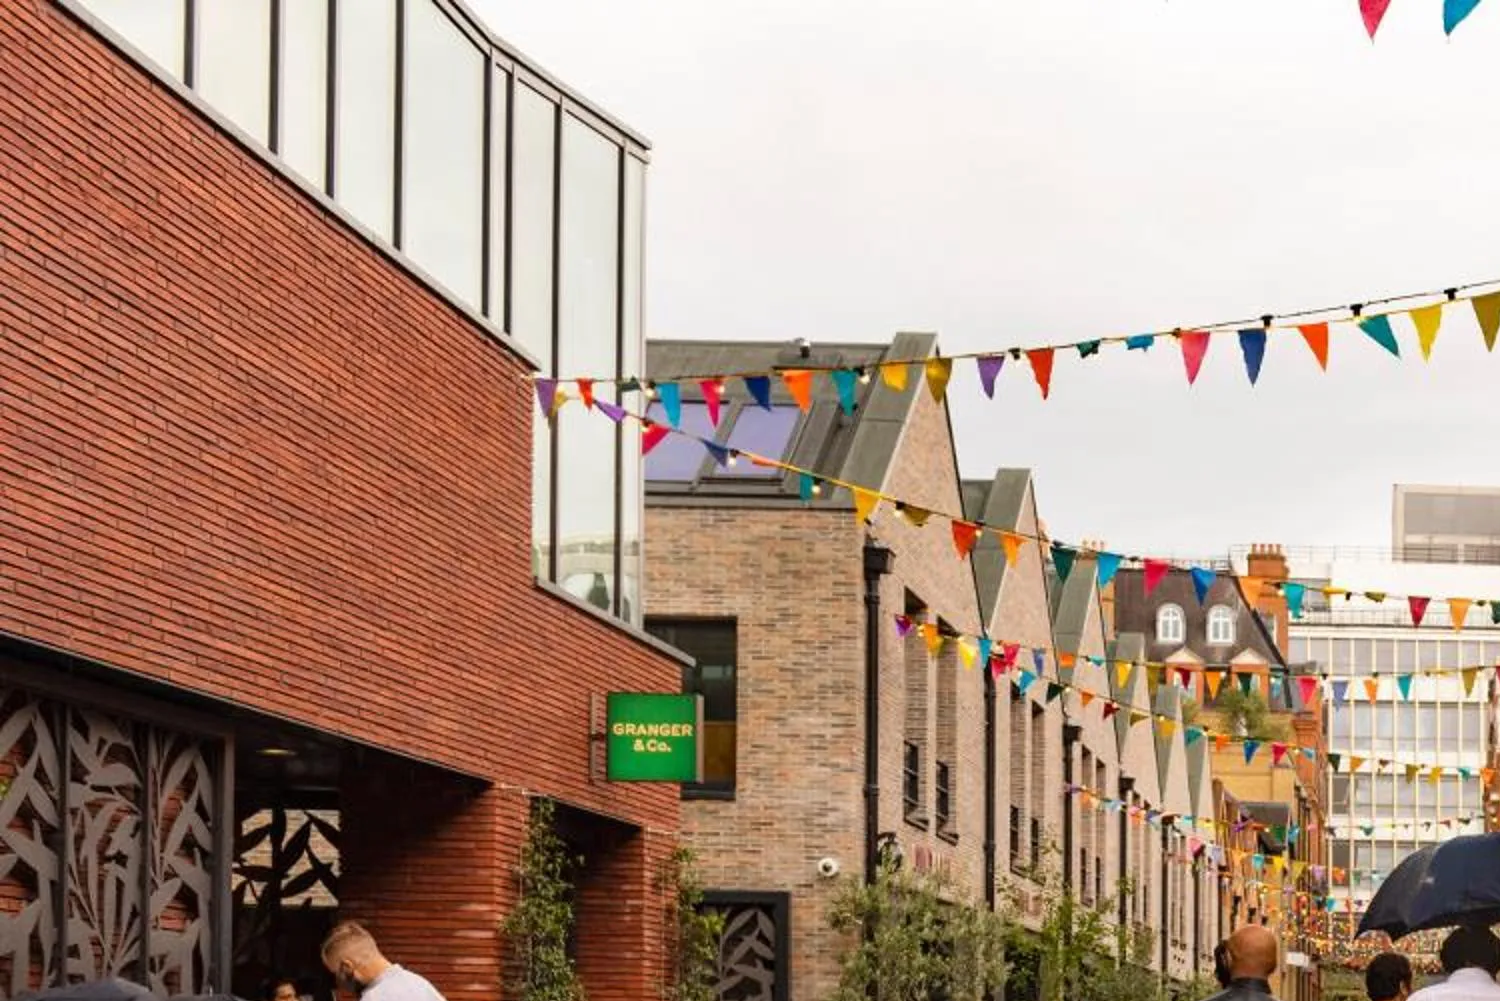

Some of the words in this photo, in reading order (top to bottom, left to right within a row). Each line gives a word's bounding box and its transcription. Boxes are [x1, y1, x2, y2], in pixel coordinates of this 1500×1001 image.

[613, 723, 693, 736] GRANGER
[634, 739, 645, 752] &
[647, 739, 672, 752] Co.
